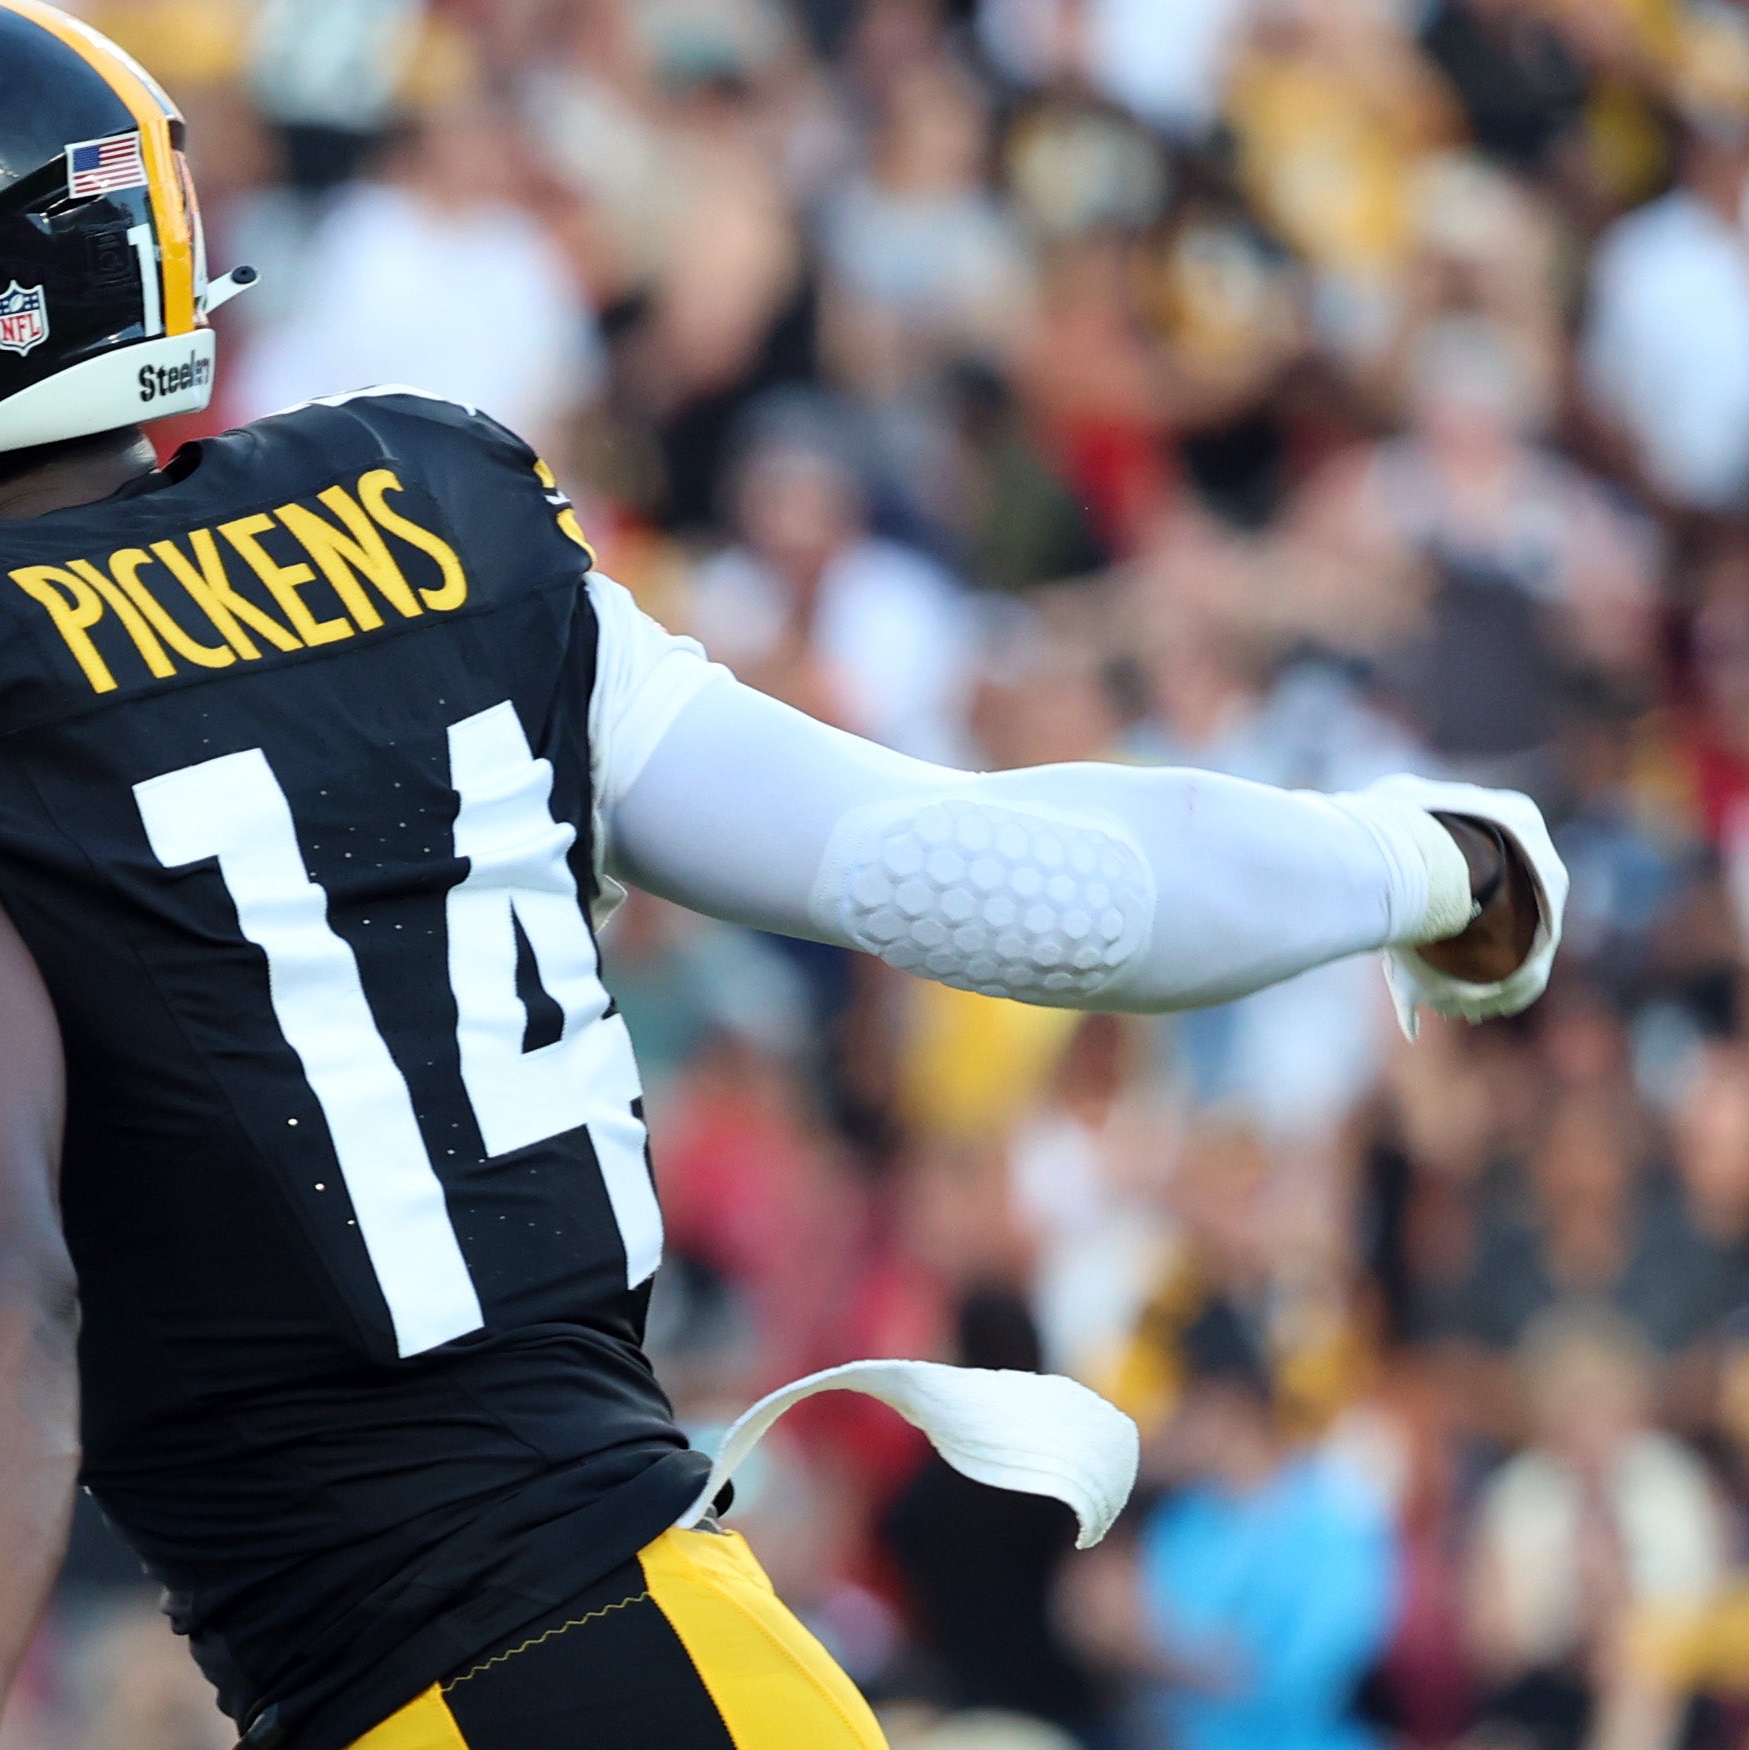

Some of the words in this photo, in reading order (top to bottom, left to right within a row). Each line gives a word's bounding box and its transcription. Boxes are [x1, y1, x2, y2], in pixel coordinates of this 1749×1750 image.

[1, 312, 41, 344] NFL
[7, 468, 468, 694] PICKENS
[132, 699, 665, 1360] 14
